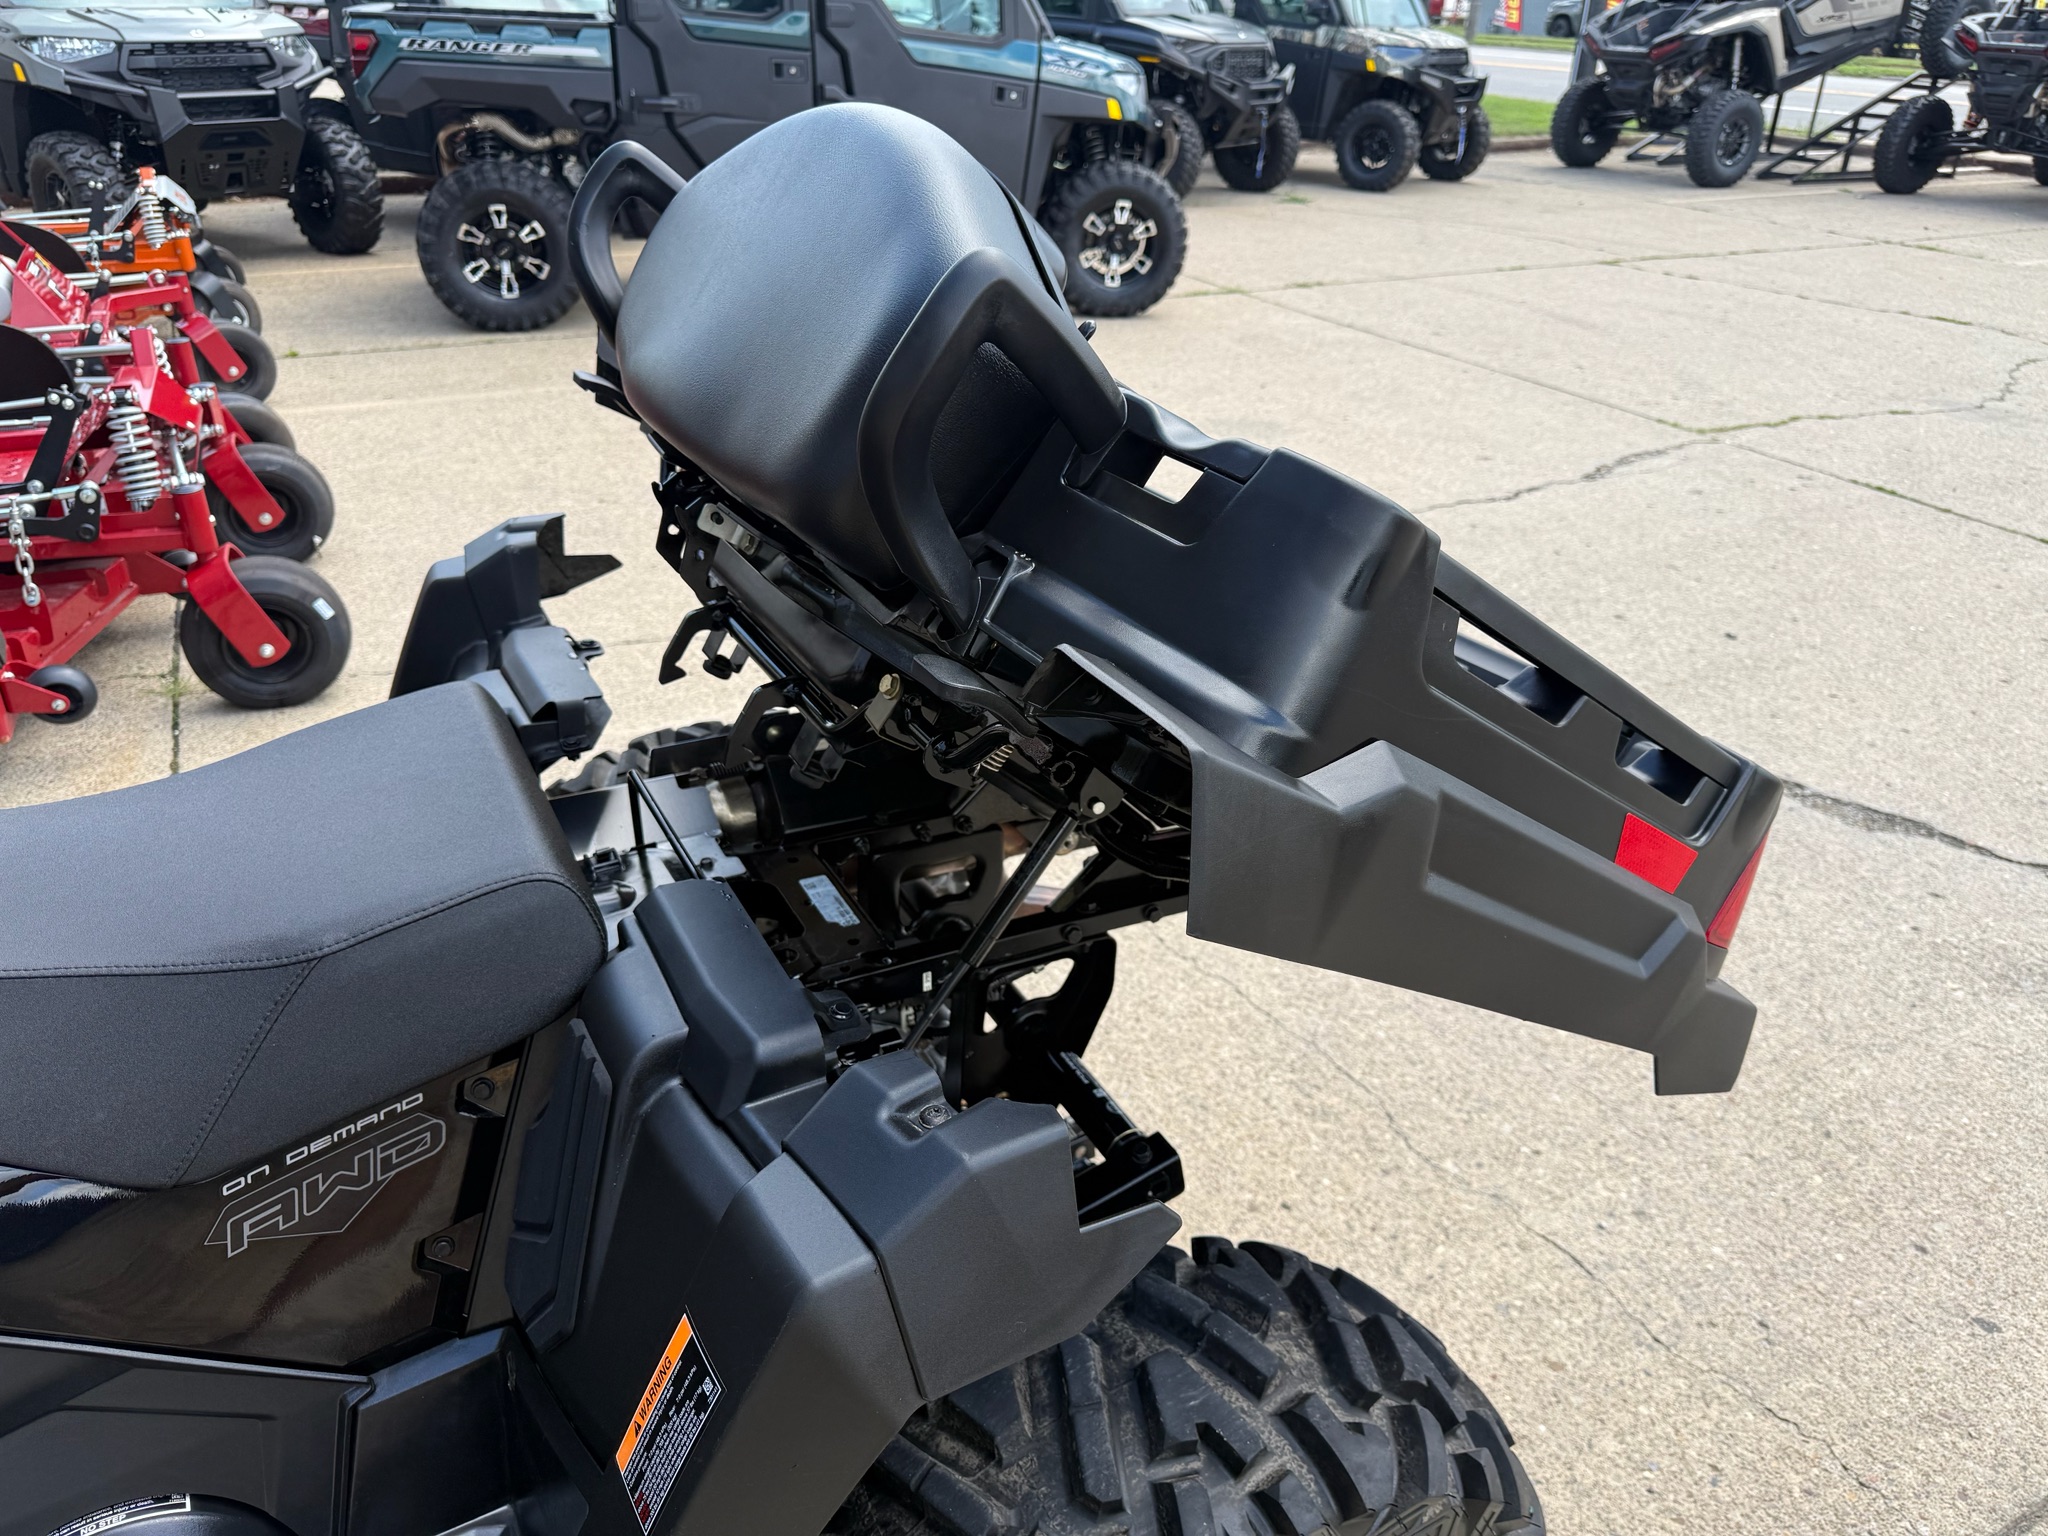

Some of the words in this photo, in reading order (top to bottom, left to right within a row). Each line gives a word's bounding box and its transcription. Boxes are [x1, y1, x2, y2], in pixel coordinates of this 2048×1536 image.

[172, 56, 237, 67] POLARIS
[403, 37, 535, 57] RANGER
[222, 1164, 270, 1197] ON
[285, 1092, 423, 1166] DEMAND
[227, 1118, 446, 1258] AWD
[639, 1356, 672, 1421] WARNING
[80, 1524, 96, 1536] NO
[98, 1513, 127, 1528] STEP
